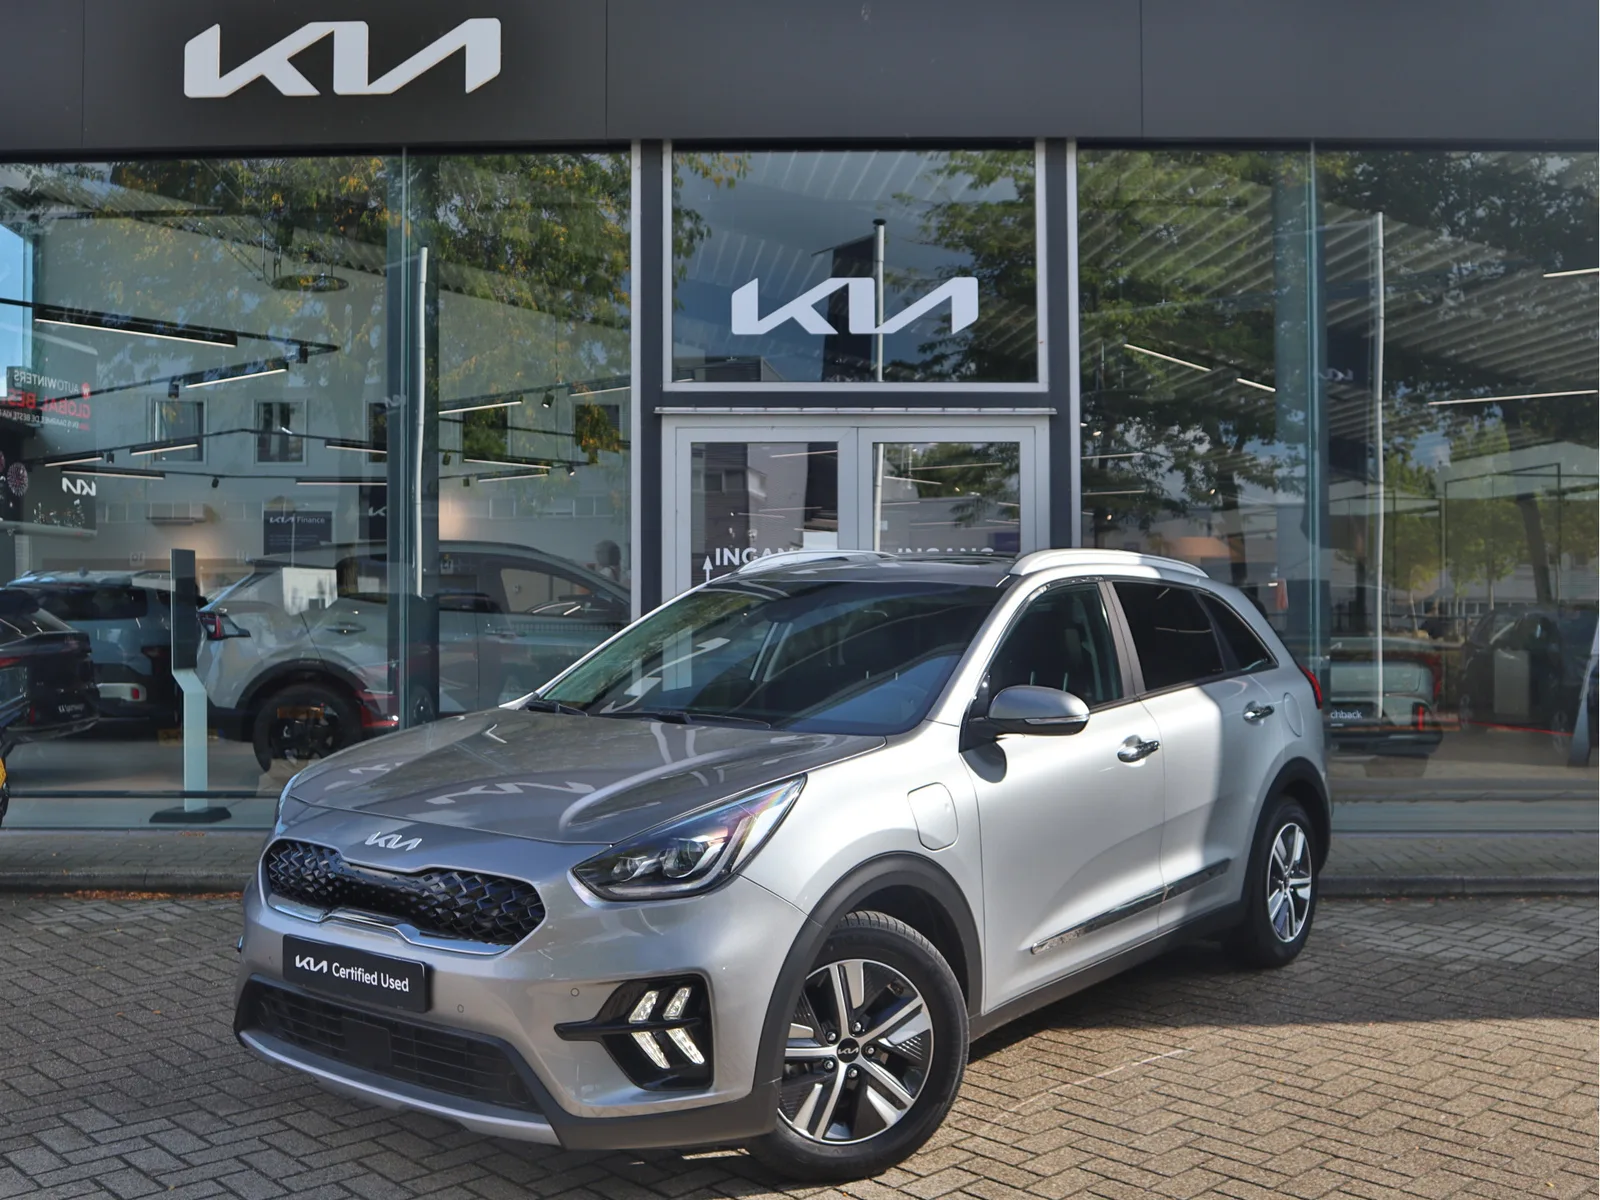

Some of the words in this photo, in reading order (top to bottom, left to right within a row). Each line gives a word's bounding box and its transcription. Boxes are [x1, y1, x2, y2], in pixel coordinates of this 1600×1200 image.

[184, 17, 501, 98] KIA
[731, 276, 979, 335] KIA
[296, 516, 326, 524] Finance
[364, 831, 423, 852] KIA
[295, 954, 328, 974] KIA
[331, 962, 378, 986] Certified
[380, 973, 409, 992] Used
[837, 1047, 859, 1055] KIA
